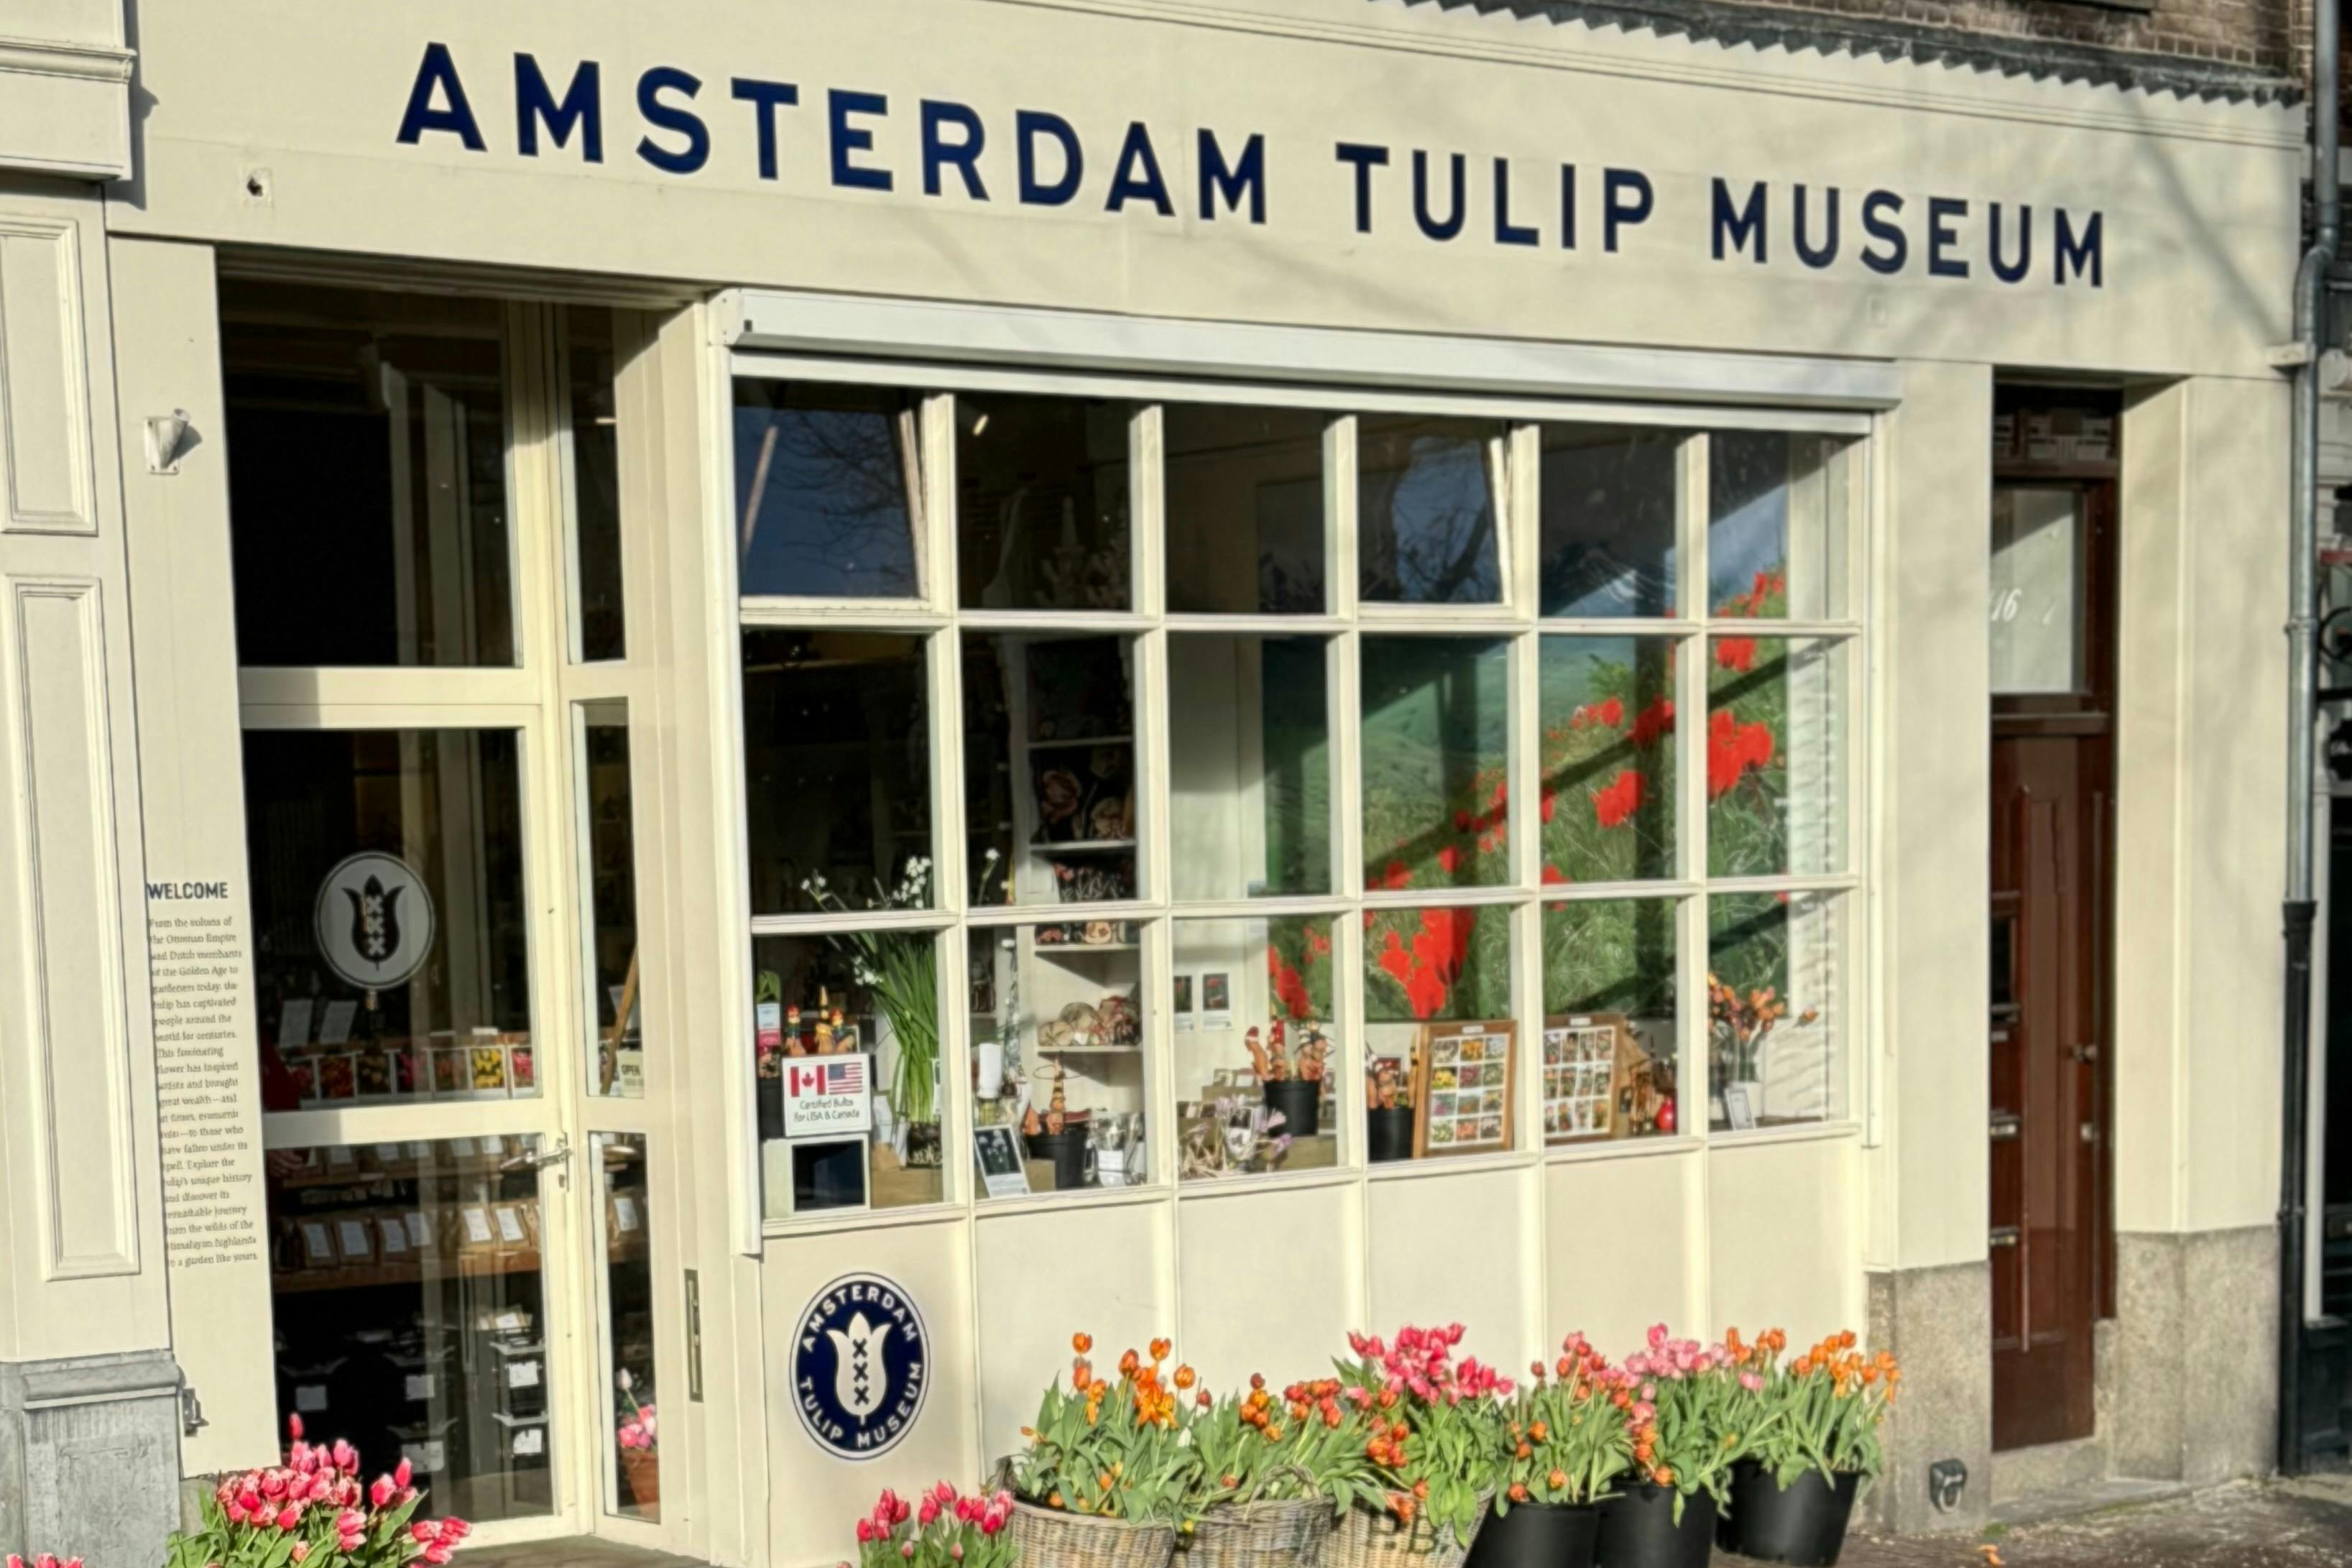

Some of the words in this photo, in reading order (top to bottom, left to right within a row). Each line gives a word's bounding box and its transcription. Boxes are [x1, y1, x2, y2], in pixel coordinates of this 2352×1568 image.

[396, 42, 1266, 224] AMSTERDAM
[1334, 142, 1654, 253] TULIP
[1710, 177, 2103, 288] MUSEUM
[1988, 589, 2023, 622] 16
[147, 882, 229, 900] WELCOME
[174, 918, 188, 928] the
[223, 916, 232, 926] of
[206, 933, 237, 945] Empire
[170, 949, 195, 960] Dutch
[162, 967, 177, 977] the
[179, 966, 210, 976] Golden
[211, 966, 227, 977] Age
[224, 979, 238, 990] the
[175, 999, 191, 1008] has
[193, 996, 236, 1010] captivated
[185, 1014, 216, 1024] around
[218, 1014, 231, 1023] the
[183, 1031, 194, 1041] for
[187, 1064, 201, 1073] has
[204, 1061, 239, 1073] inspired
[187, 1079, 203, 1089] and
[205, 1077, 239, 1089] brought
[800, 1098, 831, 1110] Certified
[834, 1097, 854, 1108] Bulbs
[794, 1112, 805, 1122] for
[806, 1111, 824, 1122] USA
[824, 1111, 831, 1120] &
[832, 1109, 860, 1120] Canada
[200, 1127, 223, 1136] those
[224, 1125, 244, 1135] who
[184, 1143, 208, 1153] fallen
[210, 1142, 235, 1152] under
[237, 1141, 248, 1150] its
[187, 1159, 219, 1171] Explore
[221, 1158, 235, 1166] the
[190, 1176, 221, 1186] unique
[222, 1173, 253, 1184] history
[183, 1191, 217, 1202] discover
[220, 1191, 230, 1199] its
[166, 1207, 212, 1219] emarkable
[214, 1206, 247, 1218] journey
[168, 1226, 186, 1235] rom
[188, 1225, 203, 1233] the
[204, 1222, 228, 1232] wilds
[229, 1220, 239, 1230] of
[240, 1219, 254, 1229] the
[214, 1236, 257, 1248] highlands
[185, 1256, 214, 1268] garden
[216, 1254, 231, 1263] like
[803, 1284, 917, 1352] AMSTERDAM
[800, 1376, 844, 1439] TULIP
[857, 1362, 921, 1448] MUSEUM
